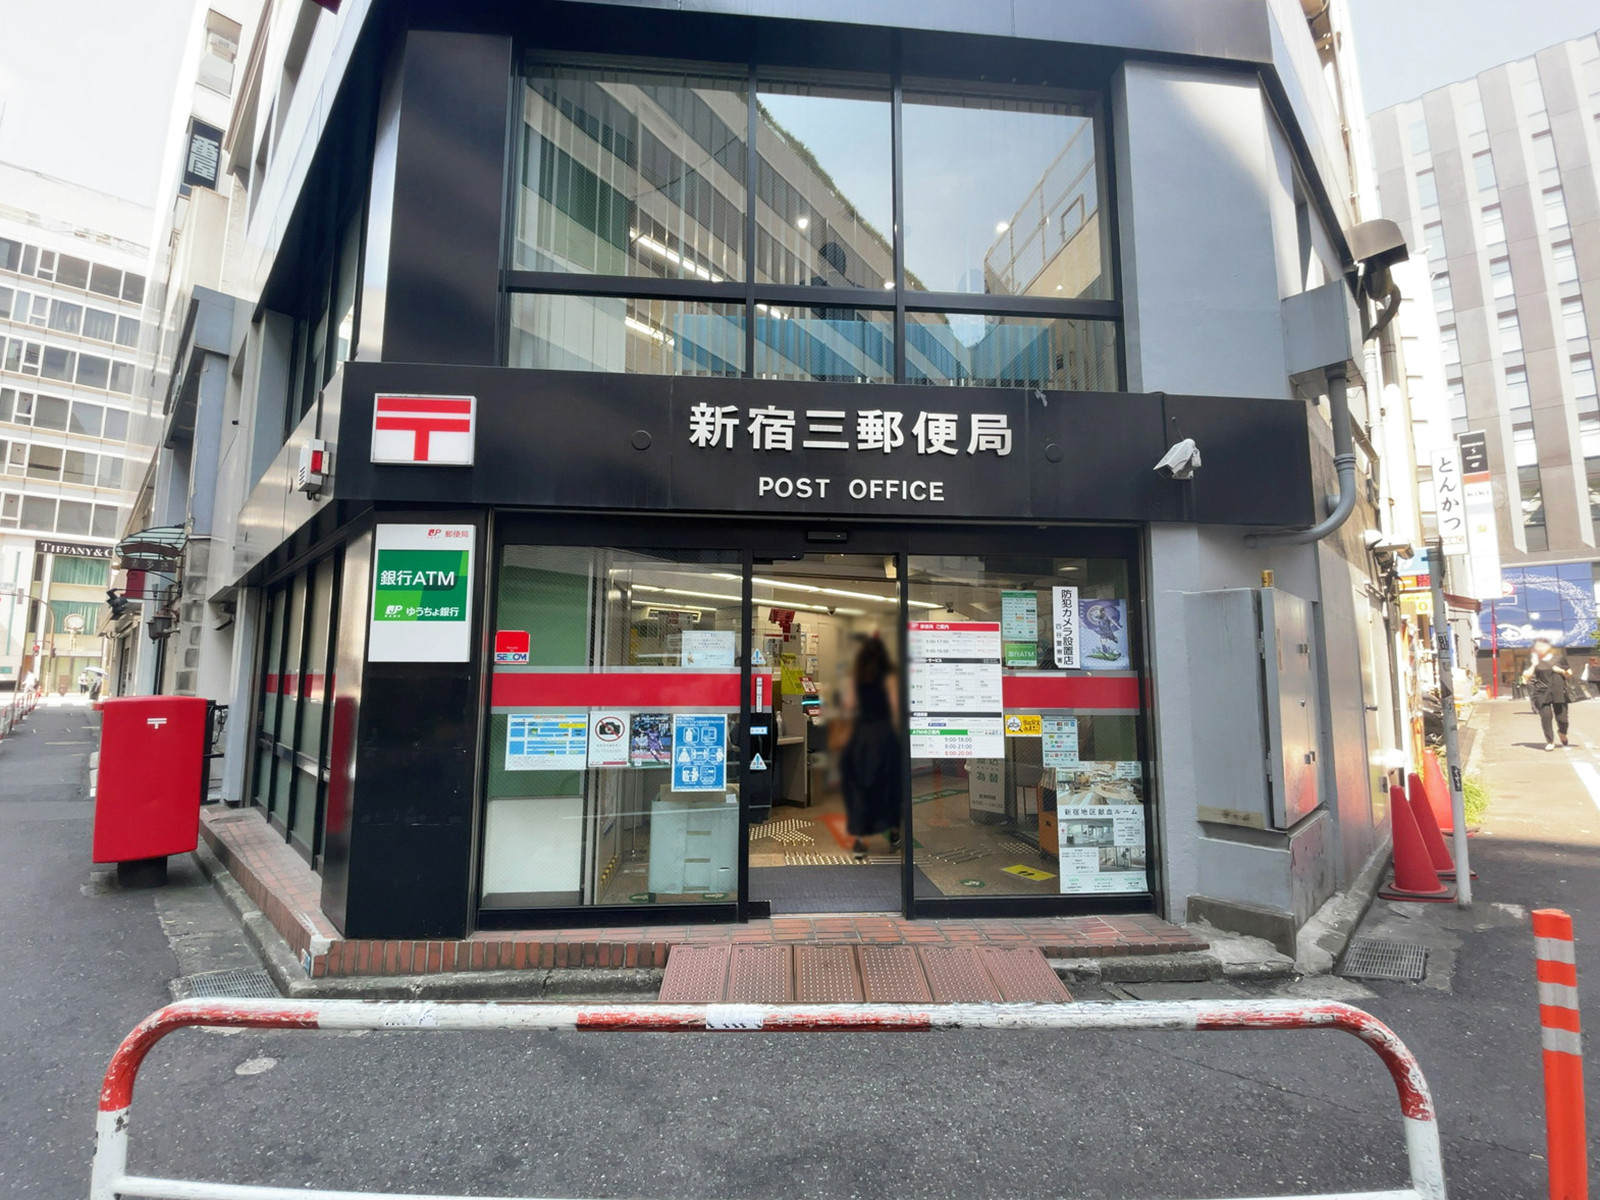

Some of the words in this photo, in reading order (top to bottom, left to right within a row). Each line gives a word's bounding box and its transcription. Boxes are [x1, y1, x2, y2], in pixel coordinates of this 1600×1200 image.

[689, 402, 1013, 456] 新宿三郵便局
[758, 477, 830, 499] POST
[849, 479, 945, 501] OFFICE
[1438, 456, 1461, 531] とんかつ
[380, 570, 455, 586] 銀行ATM
[406, 607, 459, 617] ゆうちょ銀行
[1061, 589, 1074, 665] 防犯カメラ設置店
[496, 653, 527, 661] SECOM
[1064, 808, 1138, 816] 新宿地区献血ルーム
